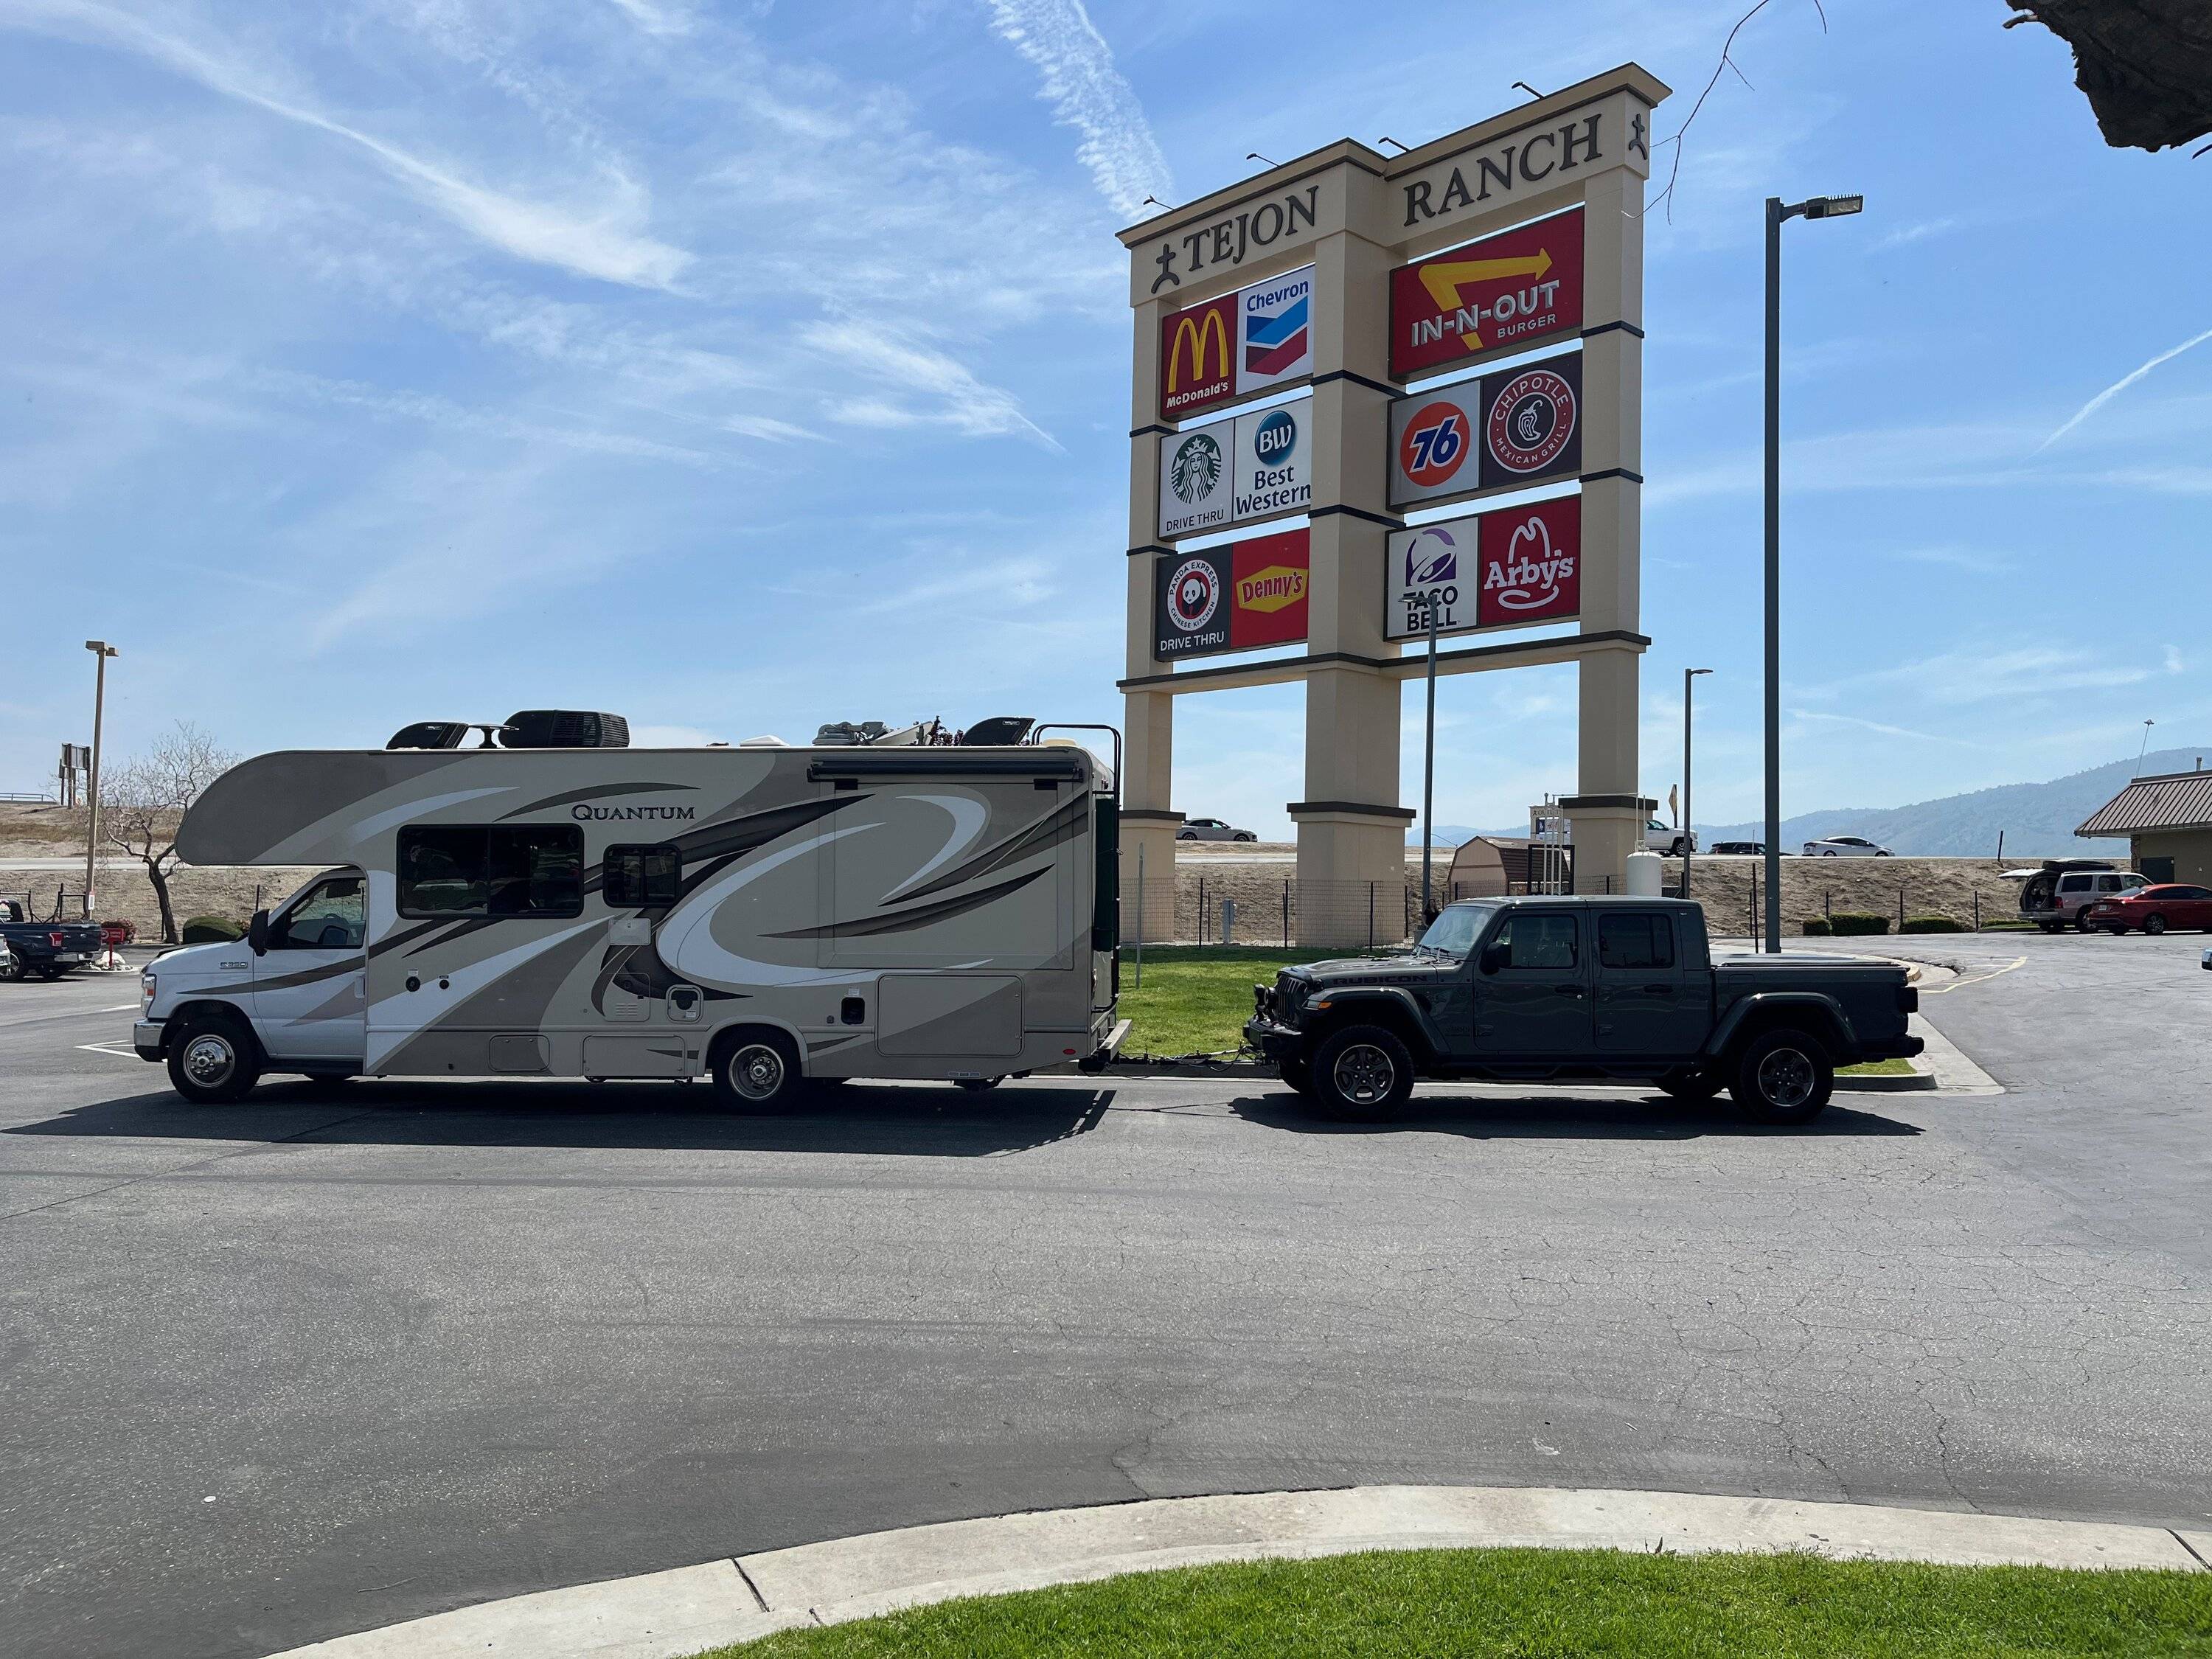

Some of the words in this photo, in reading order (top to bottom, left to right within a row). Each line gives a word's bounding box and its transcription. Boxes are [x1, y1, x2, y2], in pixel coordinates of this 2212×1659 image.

[1183, 184, 1319, 273] TEJON
[1402, 114, 1604, 227] RANCH
[1246, 280, 1309, 312] Chevron
[1411, 279, 1560, 348] IN-N-OUT
[1497, 313, 1557, 338] BURGER
[1166, 381, 1229, 408] McDonald's
[1495, 376, 1569, 422] CHIPOTLE
[1259, 424, 1293, 454] BW
[1408, 413, 1461, 474] 76
[1496, 437, 1539, 465] MEXICAN
[1541, 422, 1568, 457] GRILL
[1253, 465, 1295, 491] Best
[1235, 484, 1312, 515] Western
[1166, 515, 1194, 532] DRIVE
[1197, 509, 1225, 525] THRU
[1169, 565, 1189, 595] PANDA
[1191, 561, 1218, 588] EXPRESS
[1483, 549, 1575, 591] Arby's
[1241, 571, 1303, 604] Denny's
[1402, 585, 1458, 611] TACO
[1170, 607, 1192, 628] CHINESE
[1192, 601, 1215, 627] KITCHEN
[1160, 636, 1192, 652] DRIVE
[1193, 630, 1225, 647] THRU
[571, 804, 696, 821] QUANTUM
[1332, 975, 1428, 985] RUBICON
